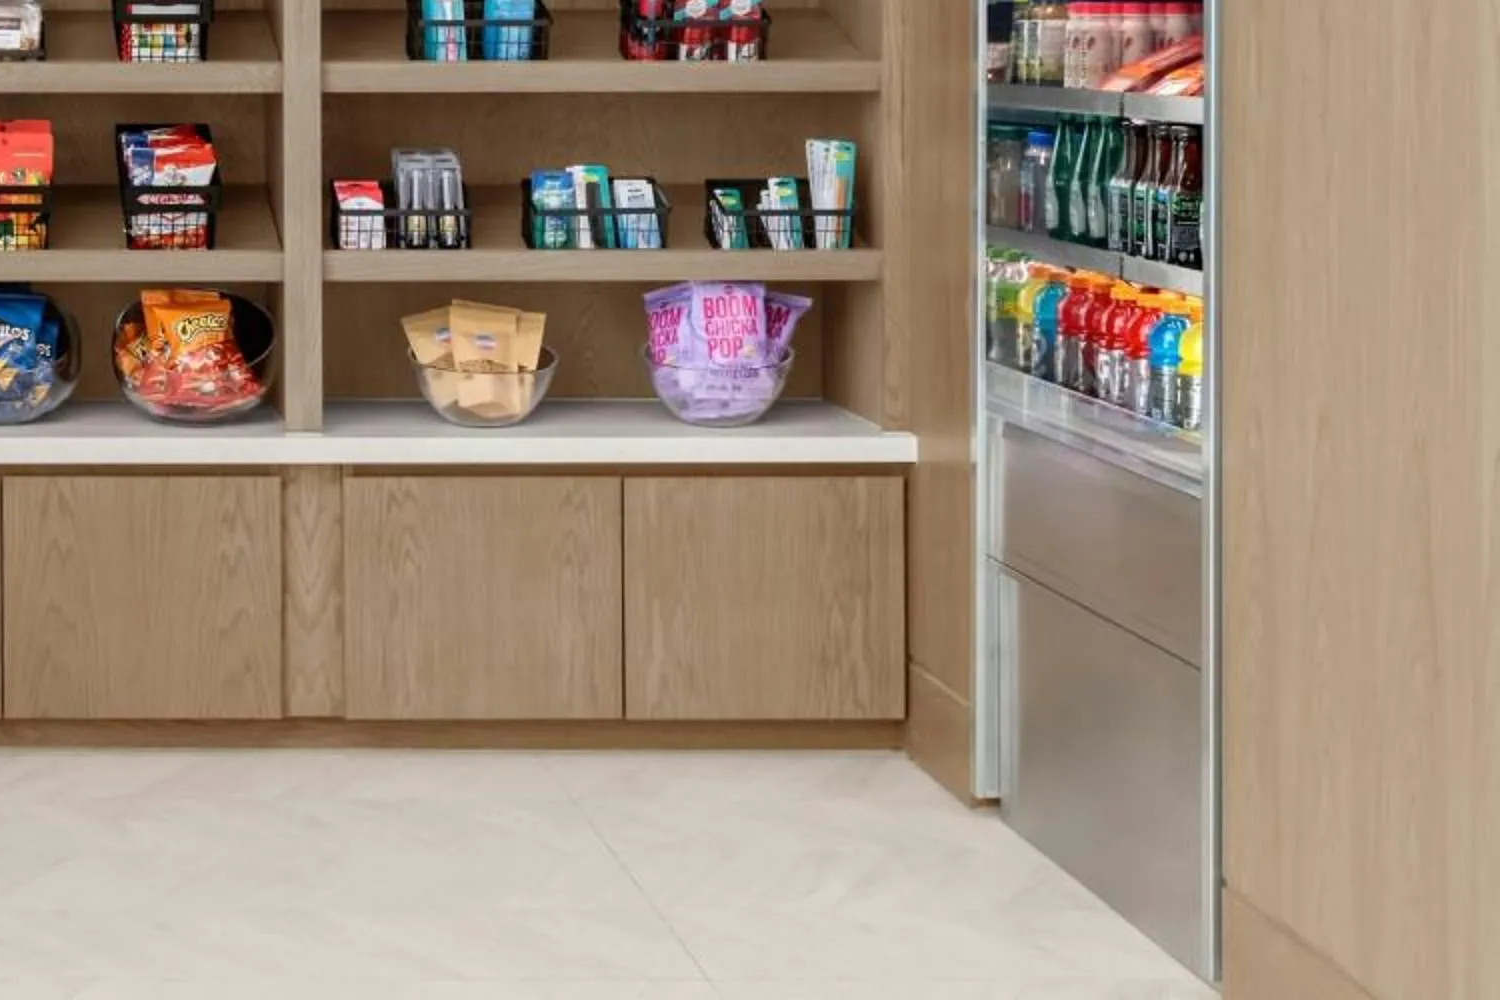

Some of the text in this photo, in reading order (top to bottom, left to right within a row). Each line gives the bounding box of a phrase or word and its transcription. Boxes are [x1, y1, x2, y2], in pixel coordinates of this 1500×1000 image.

[703, 295, 757, 319] BOOM
[705, 318, 759, 337] CHICKA
[707, 337, 743, 360] POP
